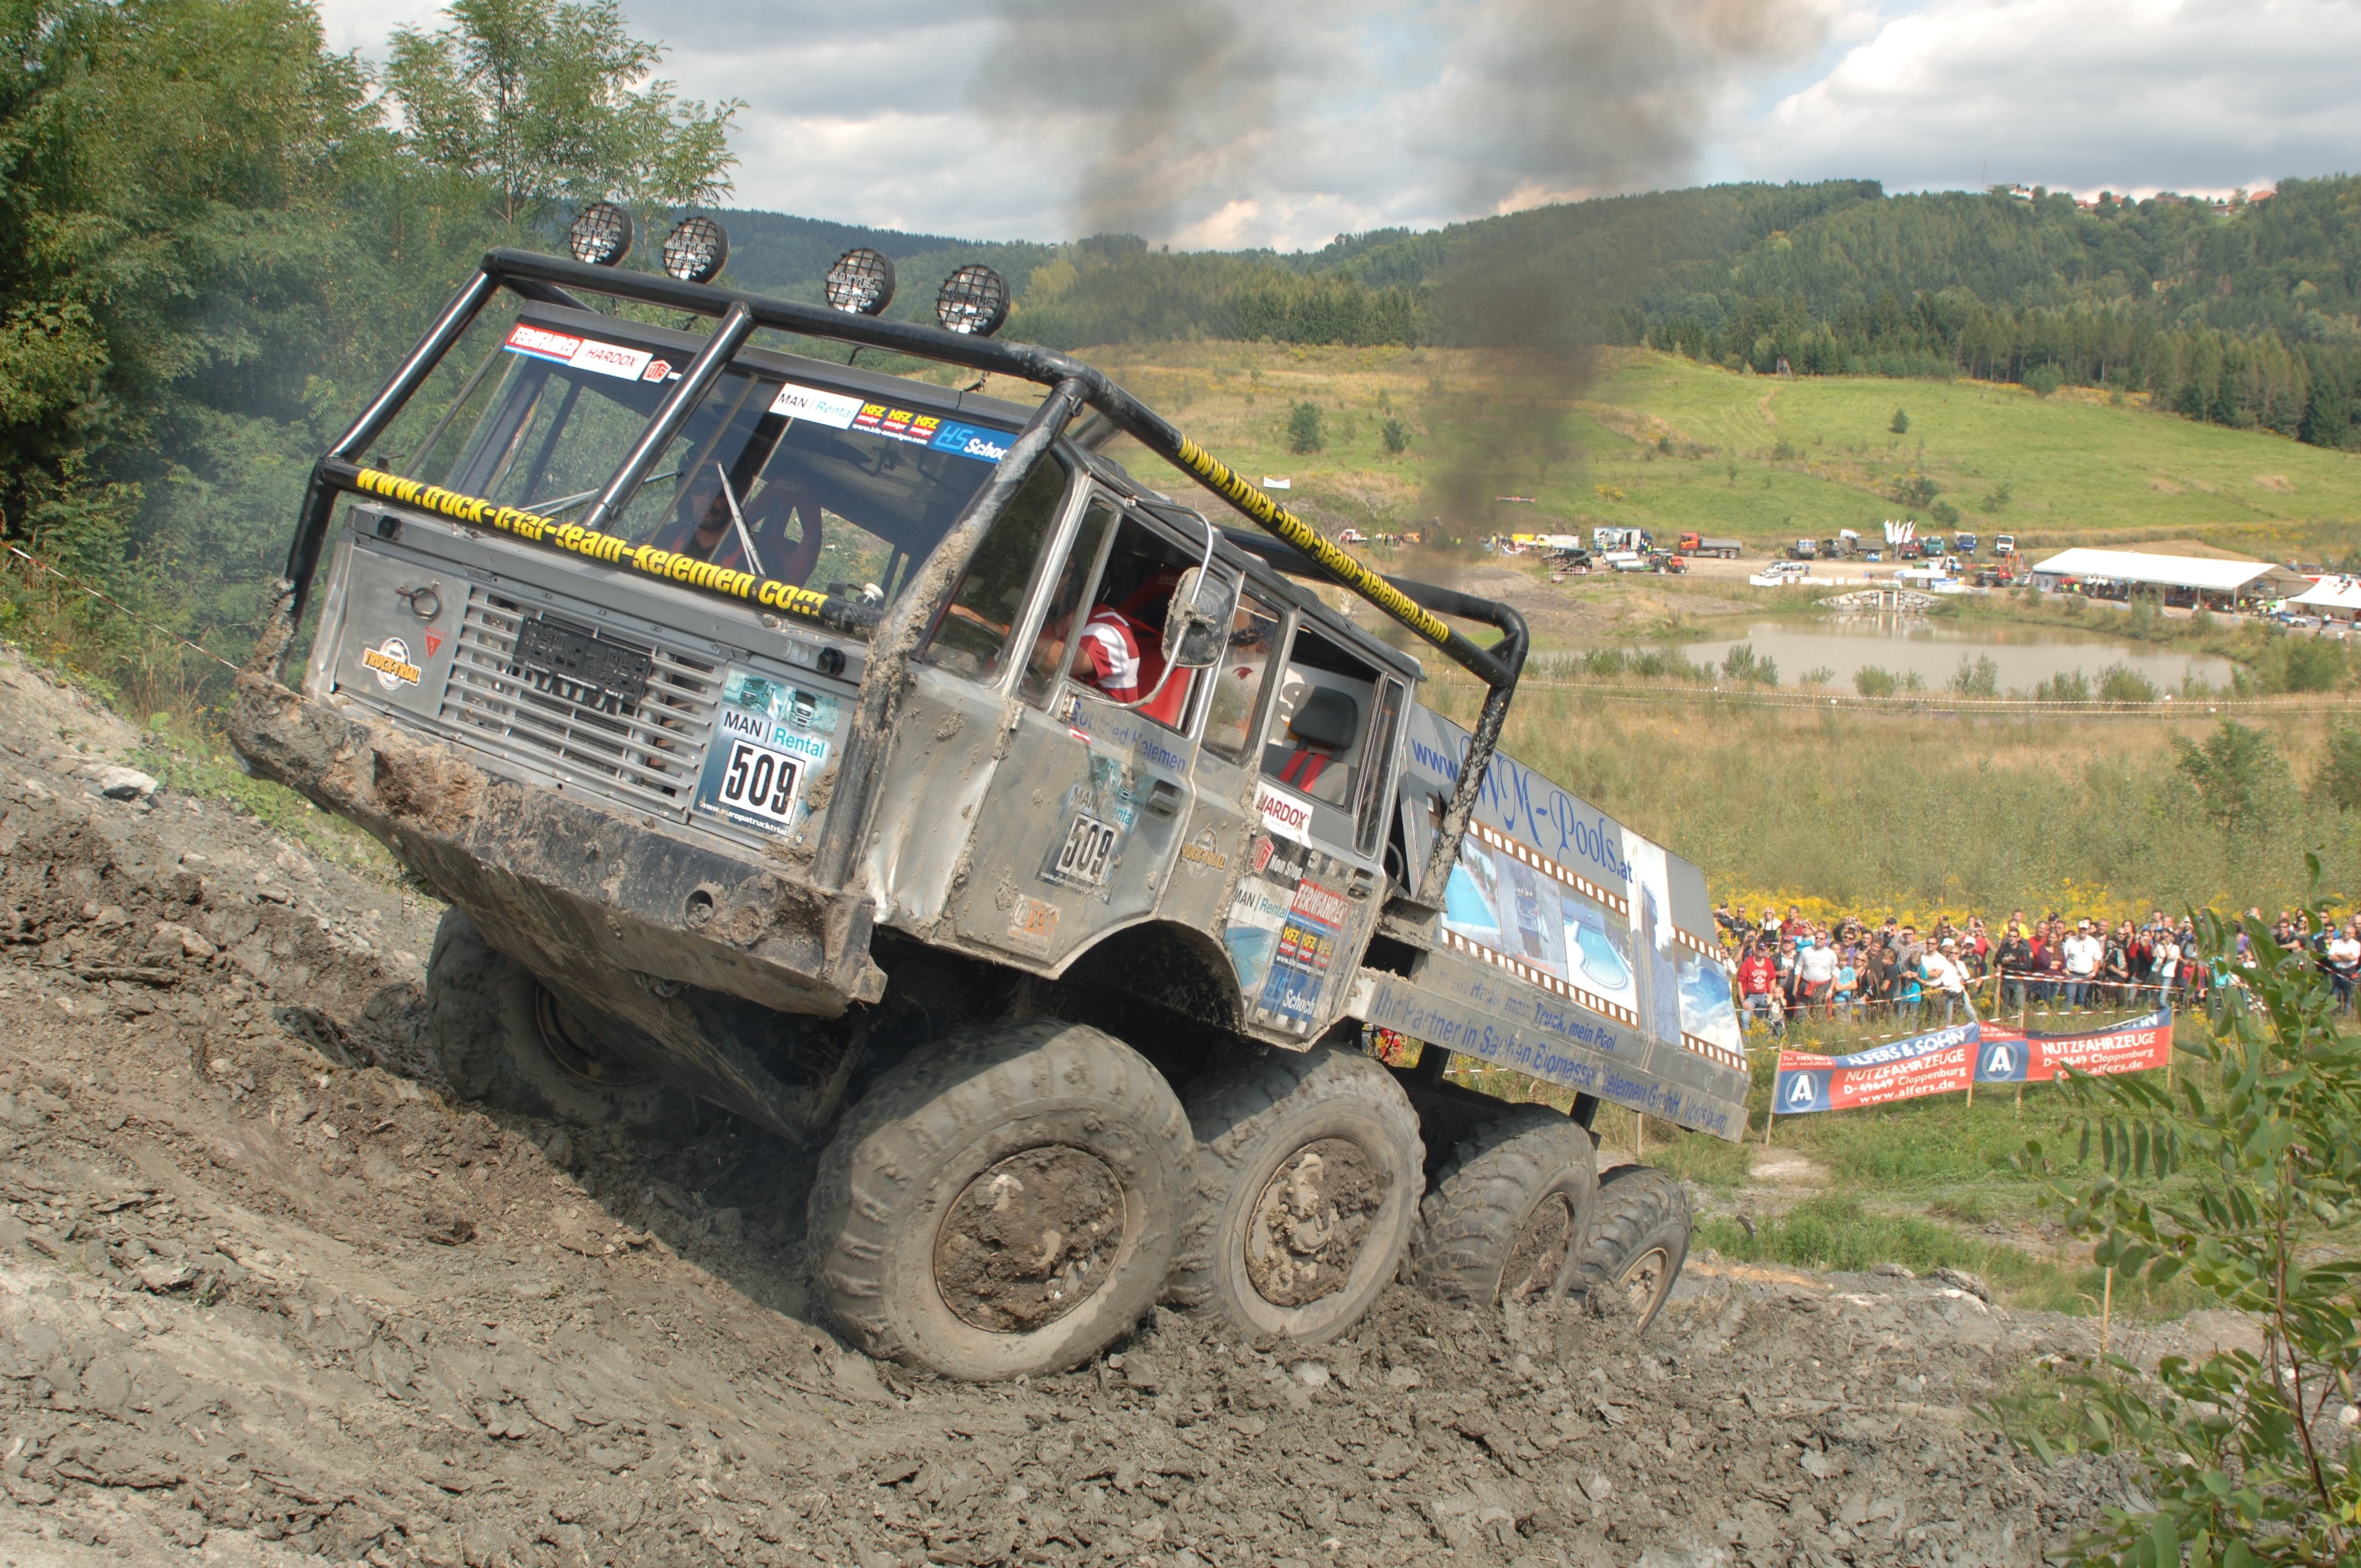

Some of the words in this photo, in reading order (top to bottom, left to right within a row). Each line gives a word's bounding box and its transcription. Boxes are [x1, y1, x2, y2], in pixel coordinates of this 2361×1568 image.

[585, 347, 639, 367] HARDOX
[777, 393, 808, 409] MAN
[815, 401, 856, 418] Rental
[861, 403, 887, 417] KFZ
[887, 409, 914, 423] KFZ
[914, 415, 940, 429] KFZ
[1178, 434, 1449, 643] www.truck-trial-team-kelemen.com
[365, 651, 420, 684] TRUCK-TRIAL
[723, 711, 762, 737] MAN
[774, 727, 825, 758] Rental
[725, 744, 797, 815] 509
[1061, 816, 1114, 876] 509
[1269, 854, 1286, 874] Non
[1260, 897, 1289, 919] Rental
[1283, 927, 1301, 943] KFZ
[1301, 933, 1318, 949] KFZ
[1282, 989, 1316, 1015] Schoch
[1401, 995, 1462, 1042] Partner
[1462, 1020, 1477, 1047] in
[1479, 1025, 1532, 1065] Sachen
[1533, 1043, 1595, 1086] Biomasse
[1569, 1021, 1593, 1043] mein
[1595, 1027, 1617, 1051] Pool
[1847, 1046, 1899, 1065] ALFERS
[1901, 1044, 1914, 1057] &
[1915, 1030, 1966, 1055] SOHN
[2041, 1032, 2156, 1055] NUTZFAHRZEUGE
[1845, 1049, 1965, 1082] NUTZFAHRZEUGE
[2091, 1048, 2154, 1064] Cloppenburg
[1844, 1079, 1894, 1095] D-49649
[1898, 1066, 1966, 1086] Cloppenburg
[1859, 1080, 1955, 1103] www.alfers.de
